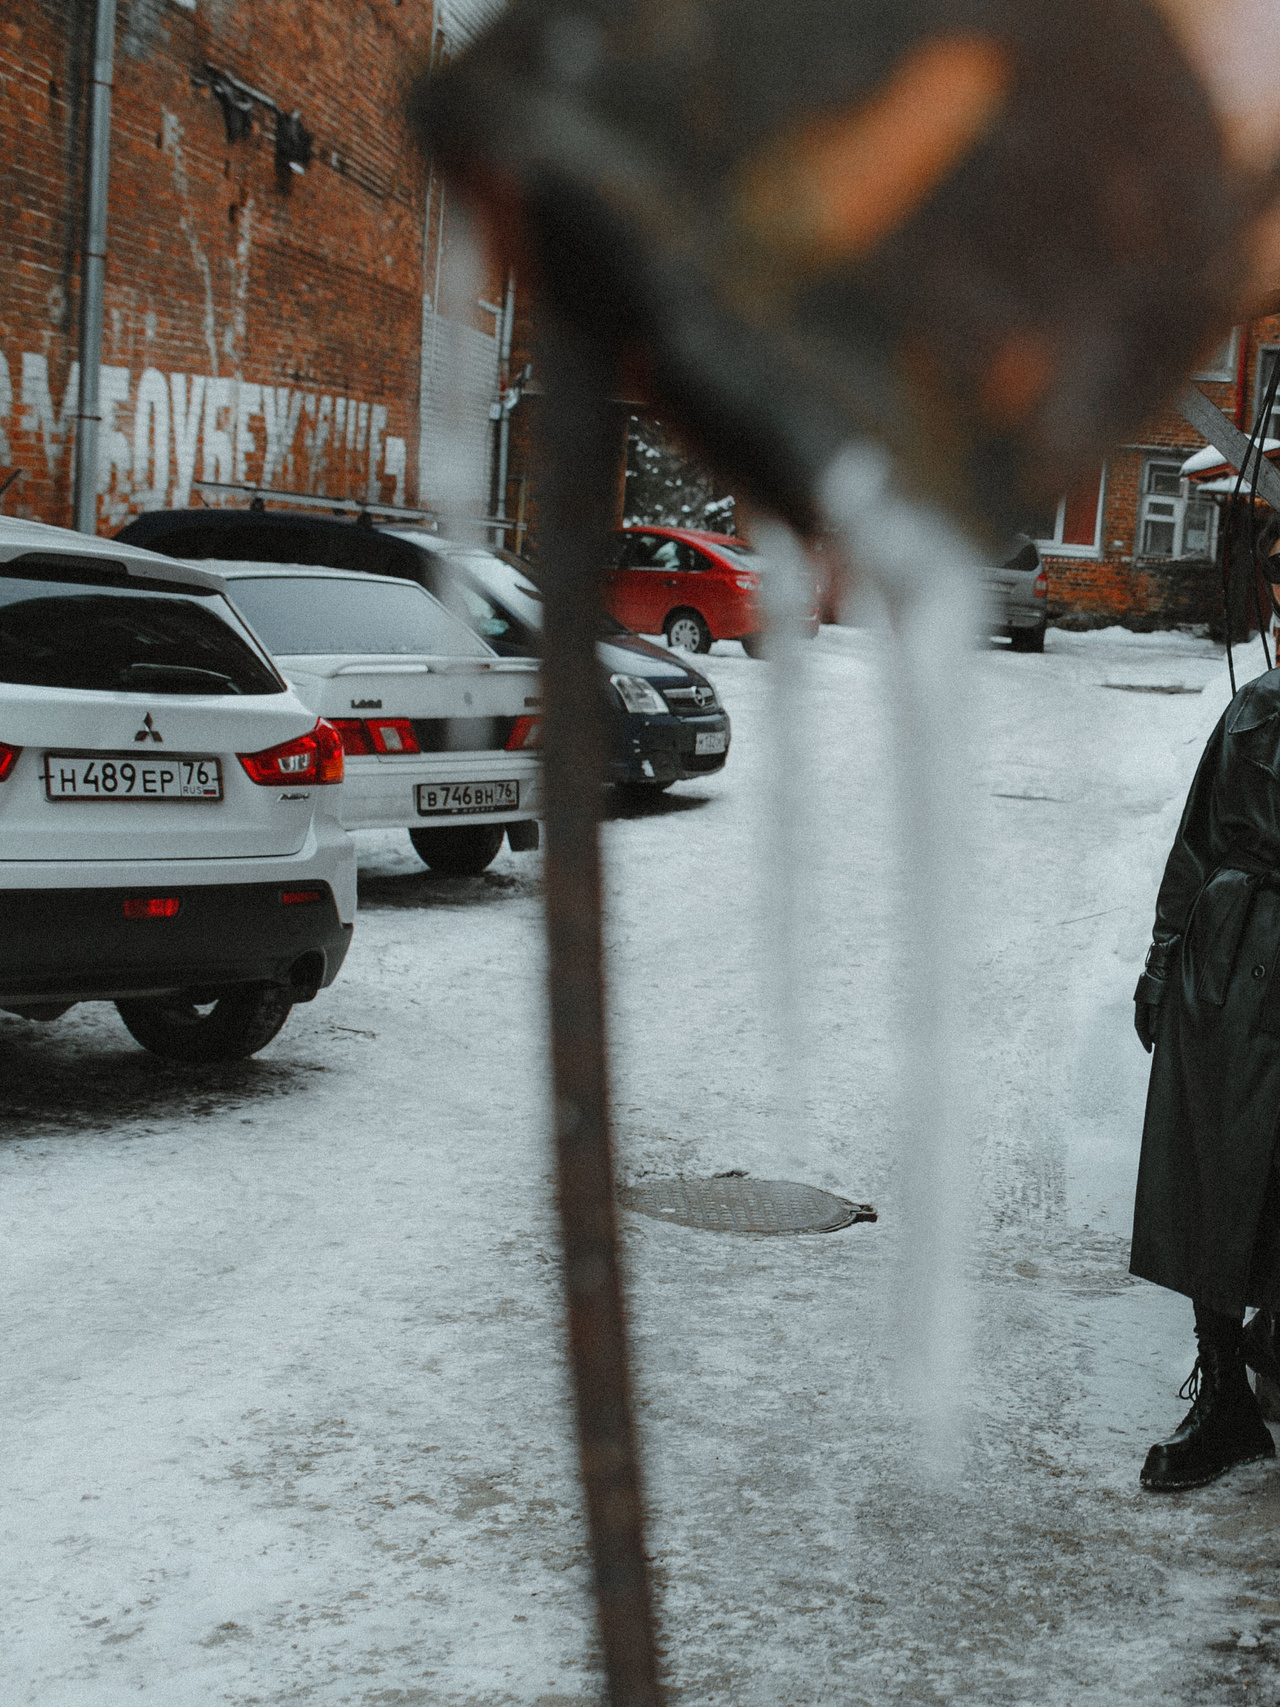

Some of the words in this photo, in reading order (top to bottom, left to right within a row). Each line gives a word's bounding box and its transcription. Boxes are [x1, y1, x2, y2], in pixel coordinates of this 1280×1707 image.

[182, 761, 209, 785] 76
[182, 785, 202, 795] RUS
[497, 783, 512, 798] 76
